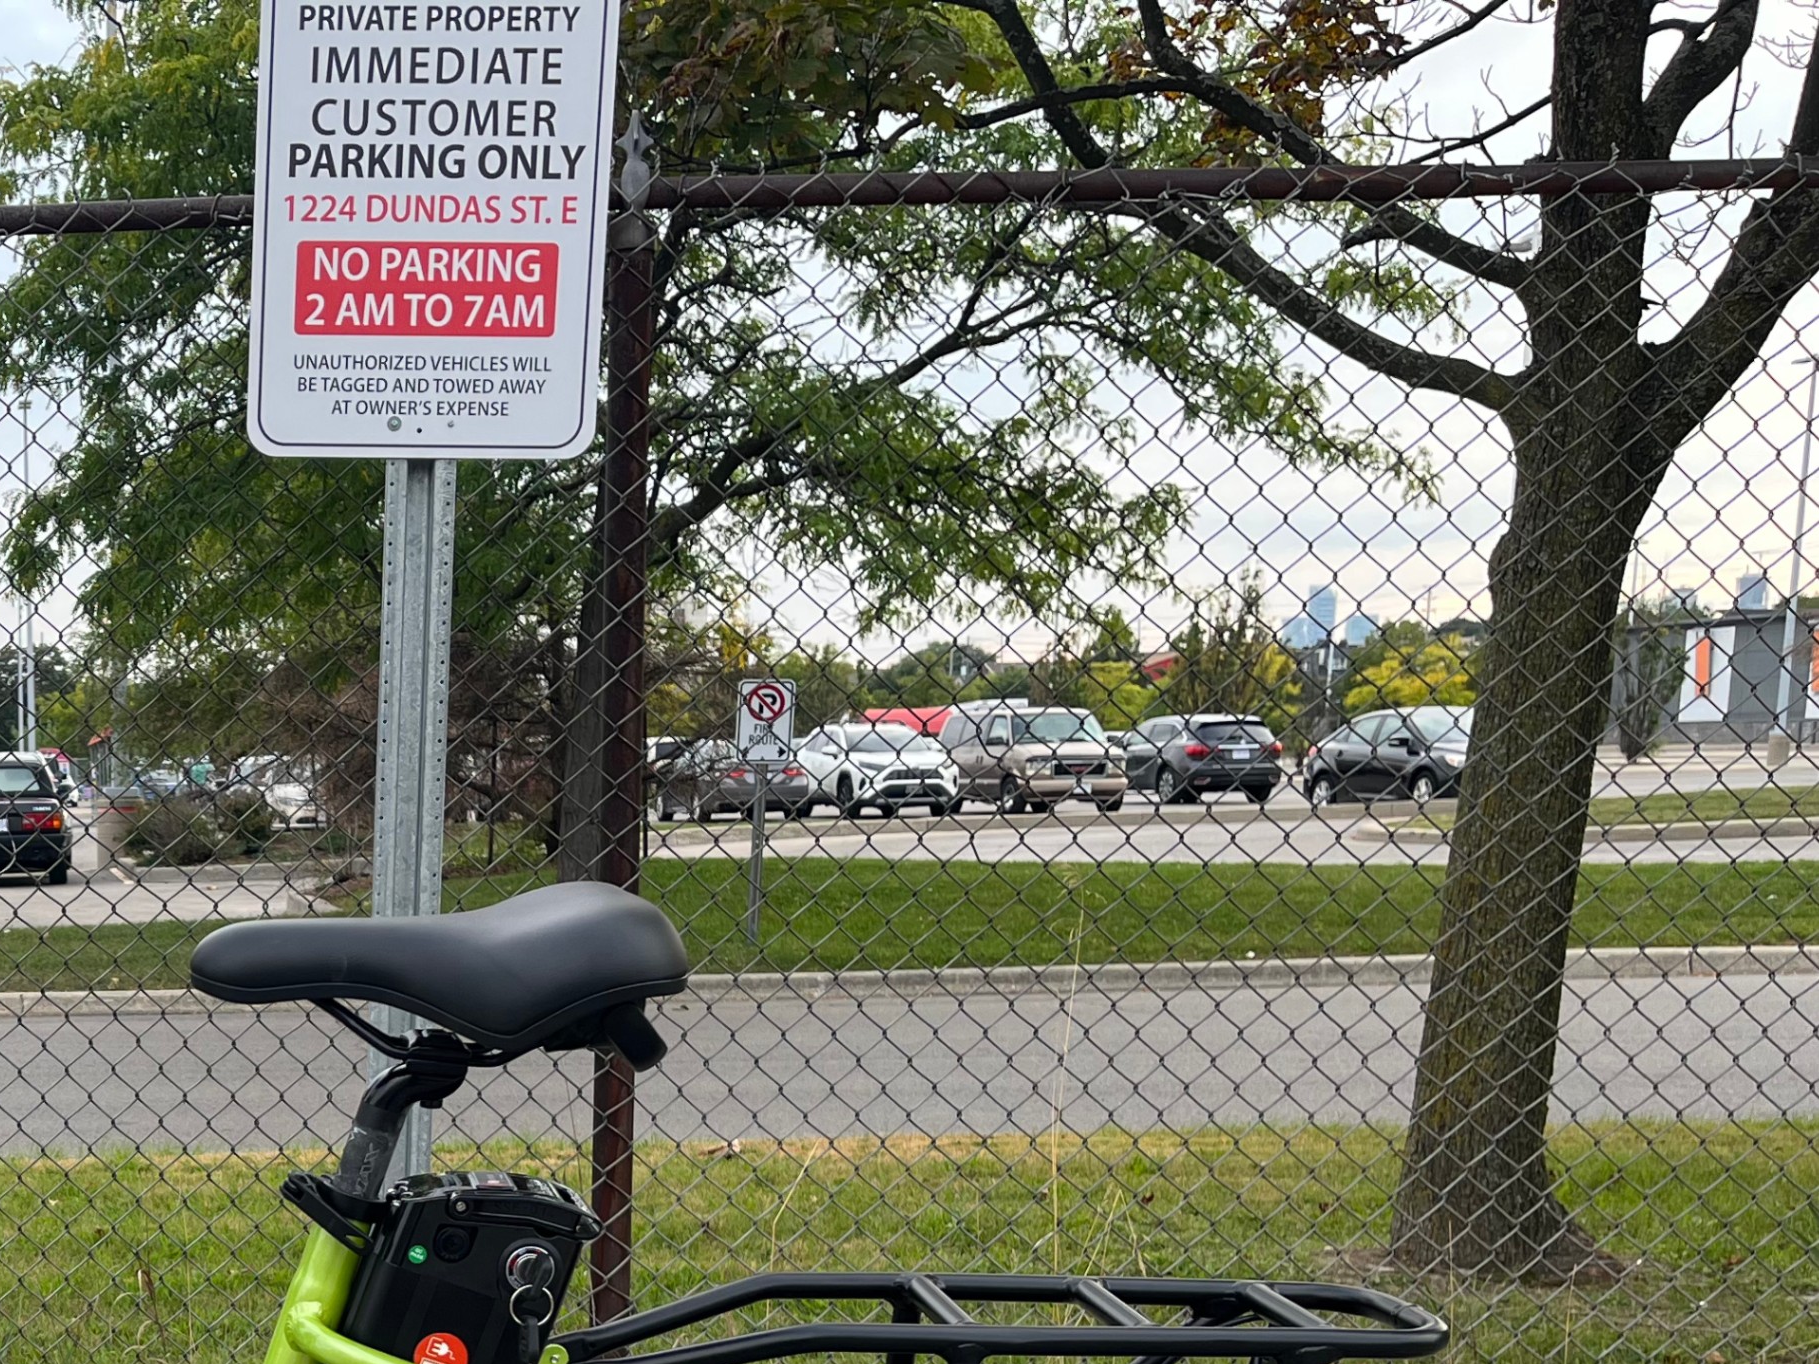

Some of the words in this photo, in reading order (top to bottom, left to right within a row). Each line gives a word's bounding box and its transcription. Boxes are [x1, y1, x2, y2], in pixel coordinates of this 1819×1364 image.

[299, 5, 417, 31] PRIVATE
[426, 6, 580, 32] PROPERTY
[312, 47, 562, 84] IMMEDIATE
[312, 99, 556, 137] CUSTOMER
[289, 143, 465, 178] PARKING
[478, 144, 586, 179] ONLY
[285, 195, 357, 222] 1224
[367, 195, 501, 223] DUNDAS
[510, 195, 552, 224] ST.
[562, 196, 578, 224] E
[315, 248, 369, 280] NO
[381, 248, 540, 282] PARKING
[305, 294, 324, 325] 2
[336, 294, 393, 325] AM
[404, 294, 452, 326] TO
[465, 295, 543, 327] 7AM
[294, 355, 426, 370] UNAUTHORIZED
[431, 356, 508, 371] VEHICLES
[513, 357, 551, 371] WILL
[298, 377, 317, 391] BE
[321, 377, 388, 392] TAGGED
[393, 378, 429, 393] AND
[433, 379, 494, 393] TOWED
[499, 379, 546, 394] AWAY
[332, 400, 351, 414] AT
[356, 400, 431, 415] OWNER'S
[437, 401, 508, 416] EXPENSE
[748, 734, 779, 746] ROUTE
[754, 723, 774, 734] FIR
